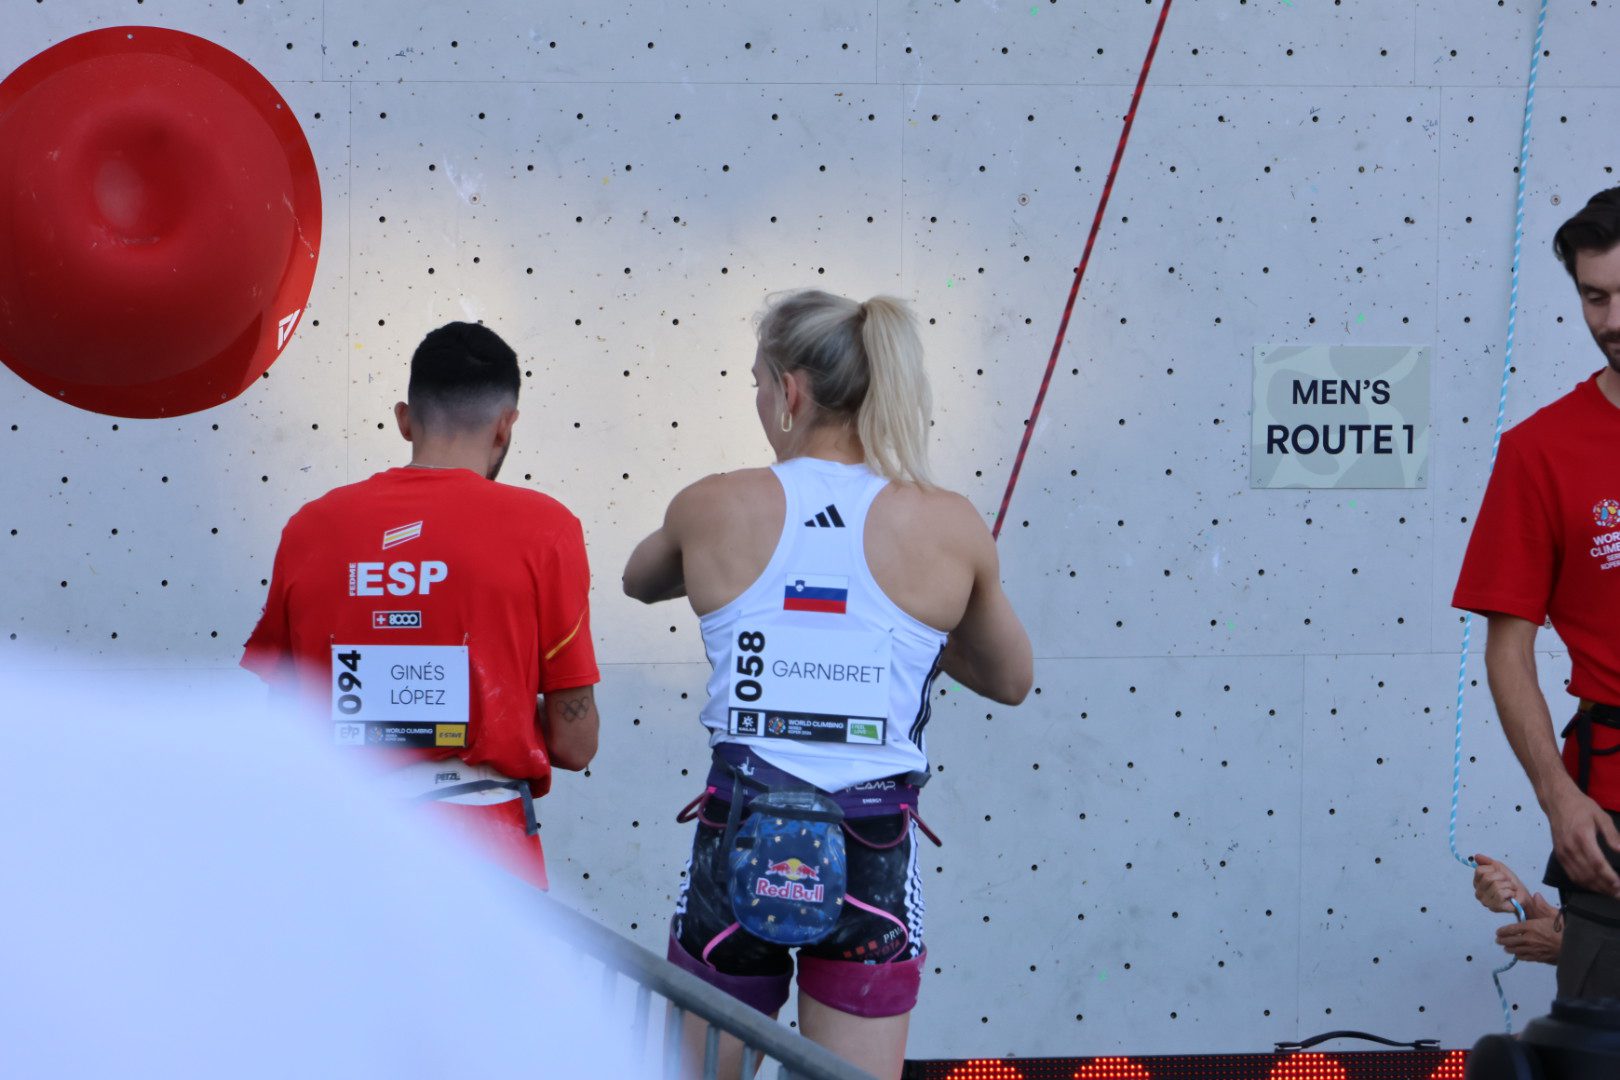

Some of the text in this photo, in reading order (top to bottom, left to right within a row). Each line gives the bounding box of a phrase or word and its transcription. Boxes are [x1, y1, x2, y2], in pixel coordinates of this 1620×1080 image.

[1292, 379, 1391, 405] MEN’S
[1266, 424, 1414, 455] ROUTE 1
[349, 562, 357, 597] FEDME
[357, 560, 449, 597] ESP
[390, 661, 445, 681] GINÉS
[735, 630, 766, 702] 058
[771, 660, 886, 684] GARNBRET
[337, 649, 363, 715] 094
[390, 685, 446, 706] LÓPEZ
[385, 727, 406, 735] WORLD
[788, 719, 844, 729] WORLD CLIMBING
[755, 876, 825, 903] Red Bull
